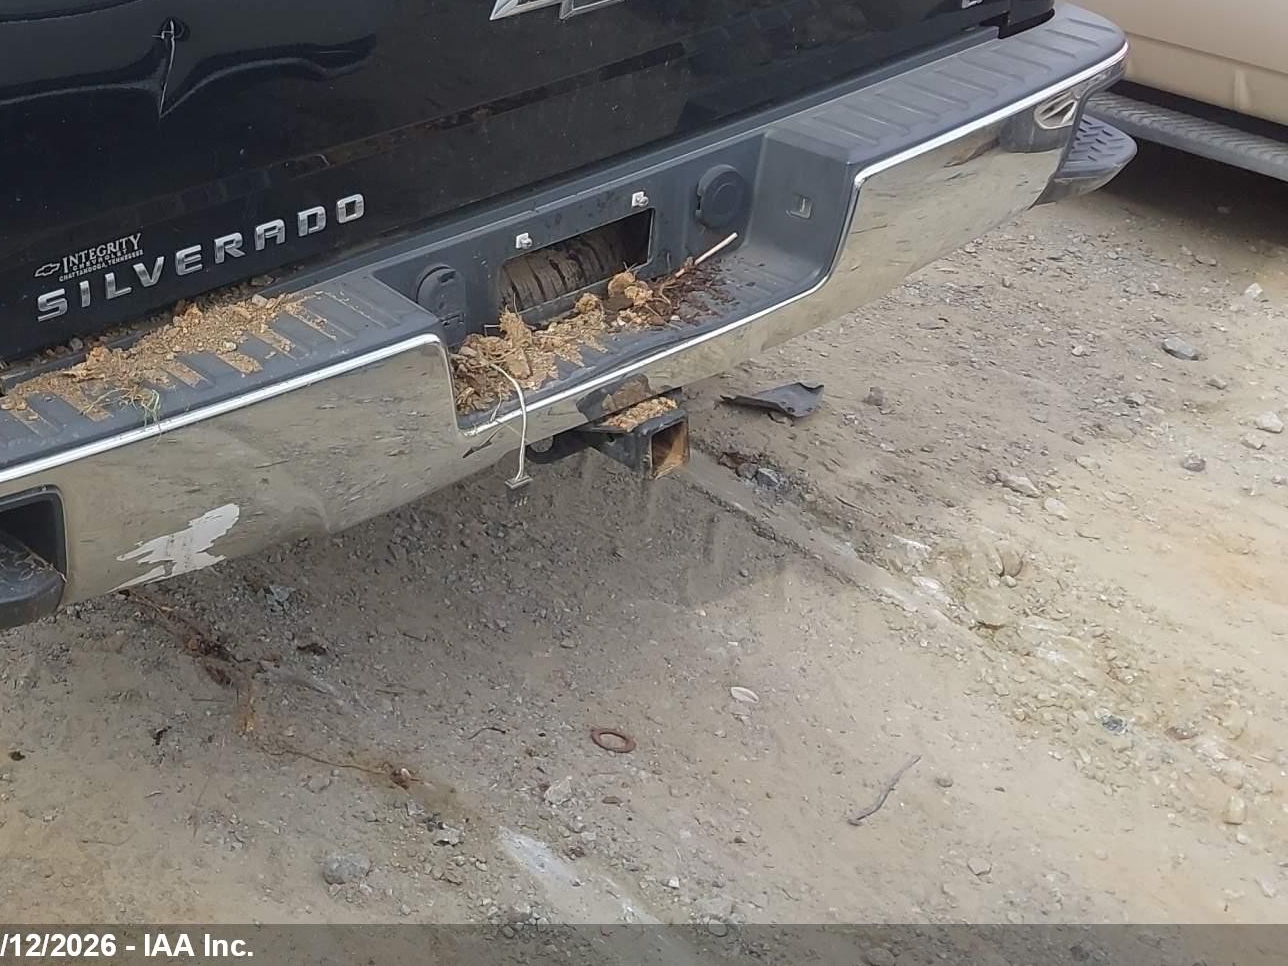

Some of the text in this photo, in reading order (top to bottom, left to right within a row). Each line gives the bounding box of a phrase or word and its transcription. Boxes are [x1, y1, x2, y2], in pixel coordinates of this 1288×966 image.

[37, 193, 366, 322] SILVERADO
[62, 233, 142, 273] INTEGRITY
[72, 248, 128, 271] CHEVROLET
